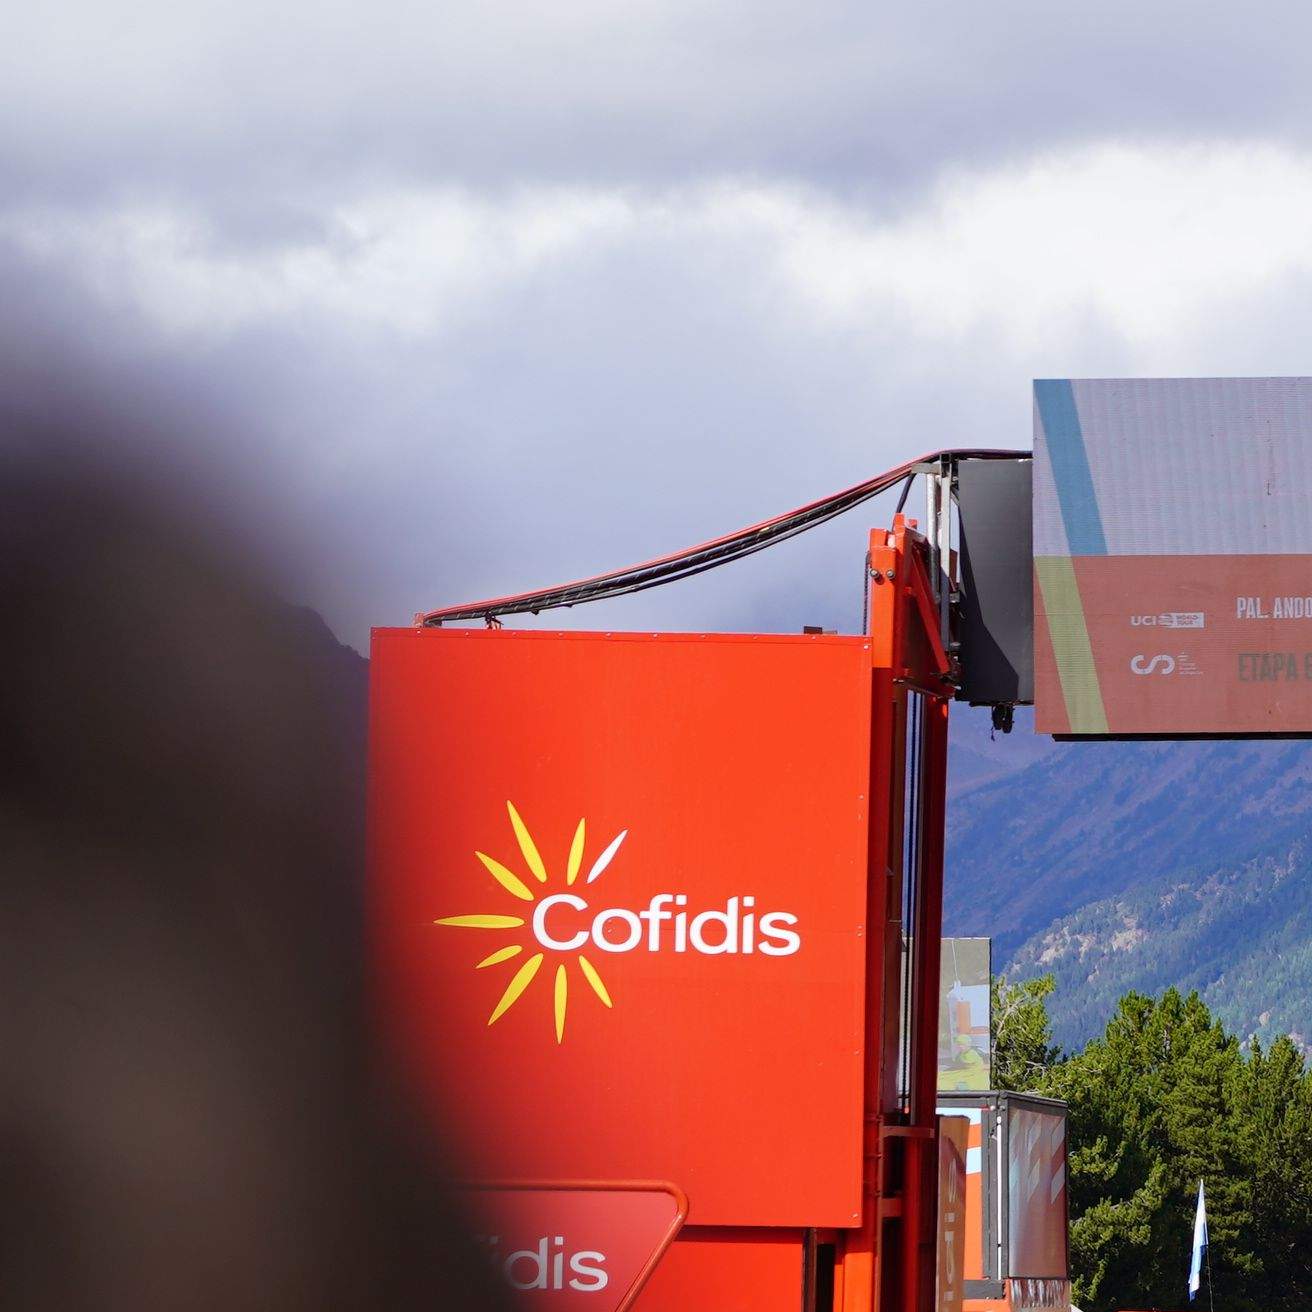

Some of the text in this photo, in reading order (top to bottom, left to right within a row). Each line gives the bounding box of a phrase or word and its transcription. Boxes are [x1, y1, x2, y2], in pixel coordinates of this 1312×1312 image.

[1131, 615, 1156, 626] UCI
[1236, 598, 1268, 618] PAL.
[1238, 652, 1297, 682] ETAPA
[532, 893, 800, 956] Cofidis
